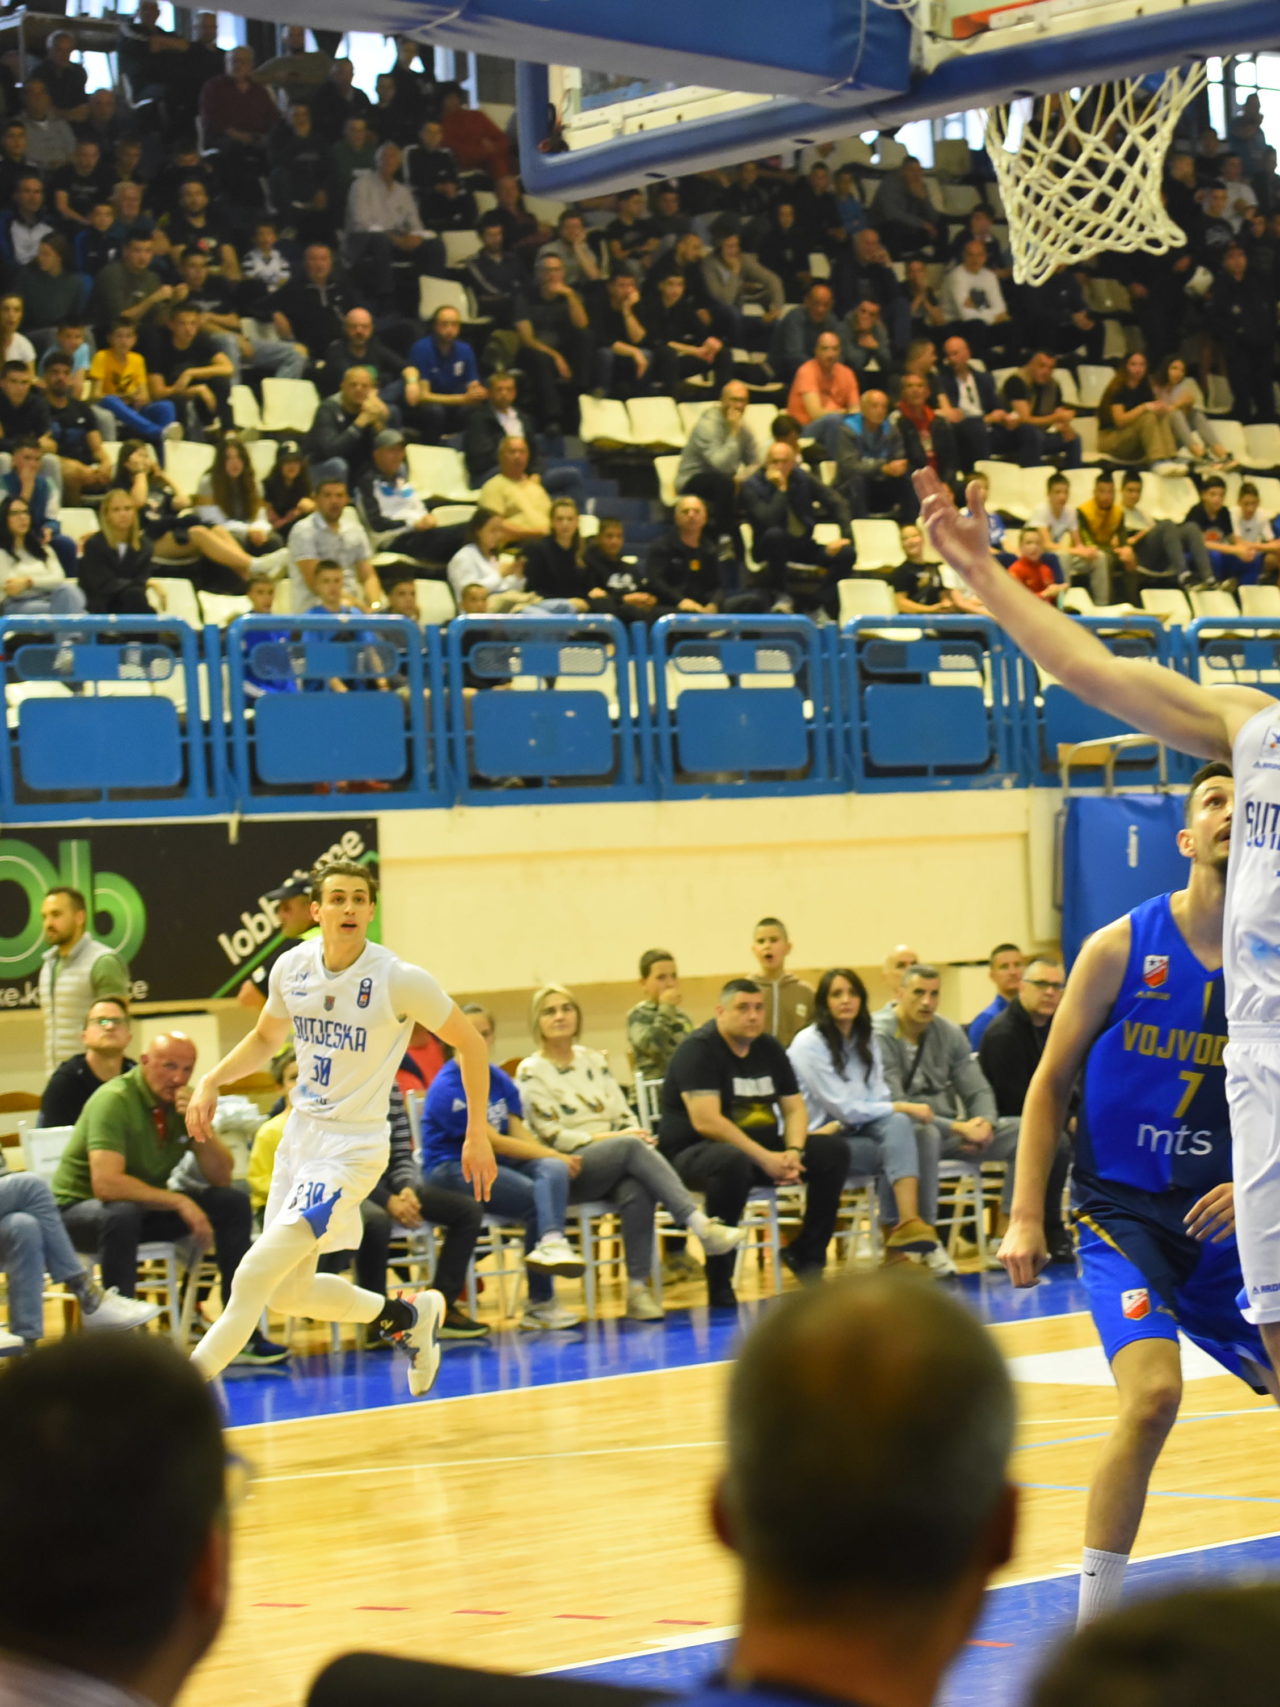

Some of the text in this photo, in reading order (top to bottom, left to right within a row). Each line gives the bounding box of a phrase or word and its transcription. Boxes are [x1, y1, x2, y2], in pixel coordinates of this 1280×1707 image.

[292, 1016, 367, 1053] SUTJESKA
[310, 1054, 332, 1087] 30
[1172, 1069, 1205, 1118] 7
[1137, 1122, 1213, 1156] mts
